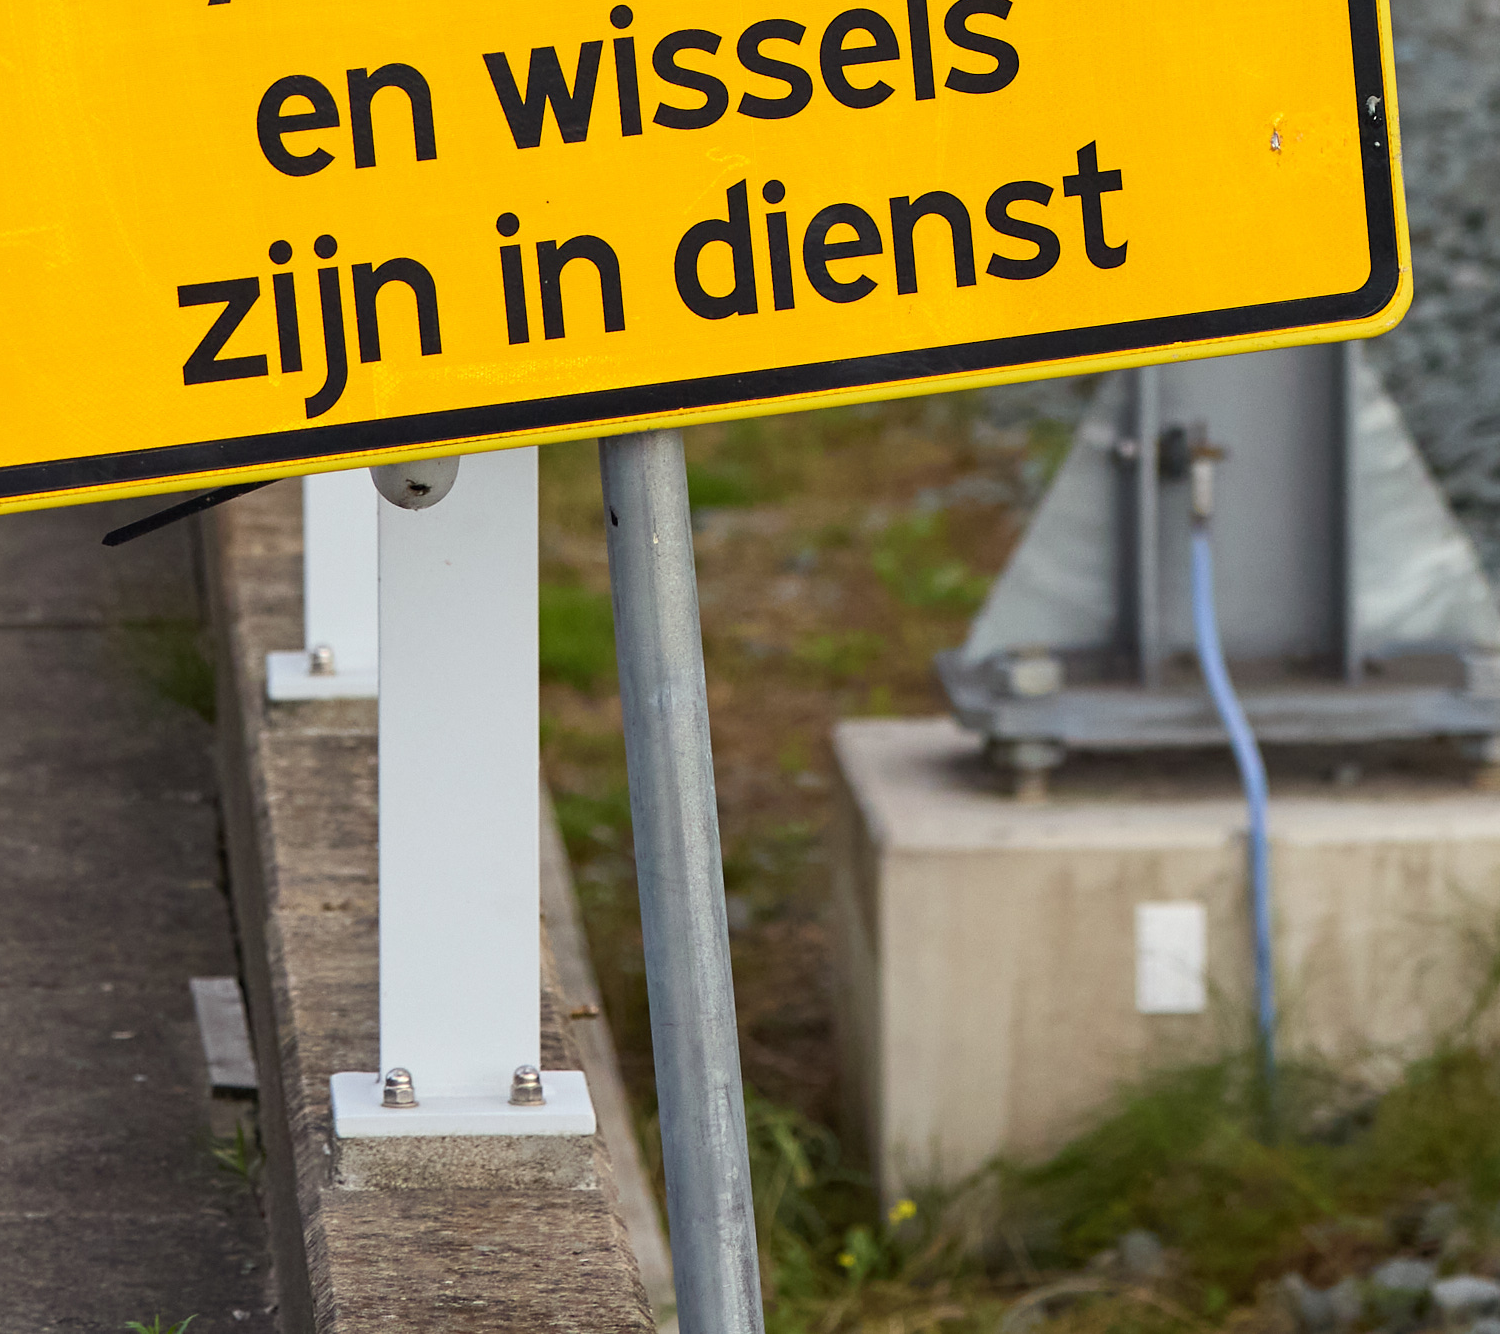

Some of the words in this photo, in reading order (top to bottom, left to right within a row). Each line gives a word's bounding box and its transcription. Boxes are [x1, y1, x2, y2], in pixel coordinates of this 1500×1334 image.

[257, 63, 437, 176] en
[178, 234, 442, 419] zijn
[496, 212, 625, 344] in
[674, 141, 1128, 320] dienst
